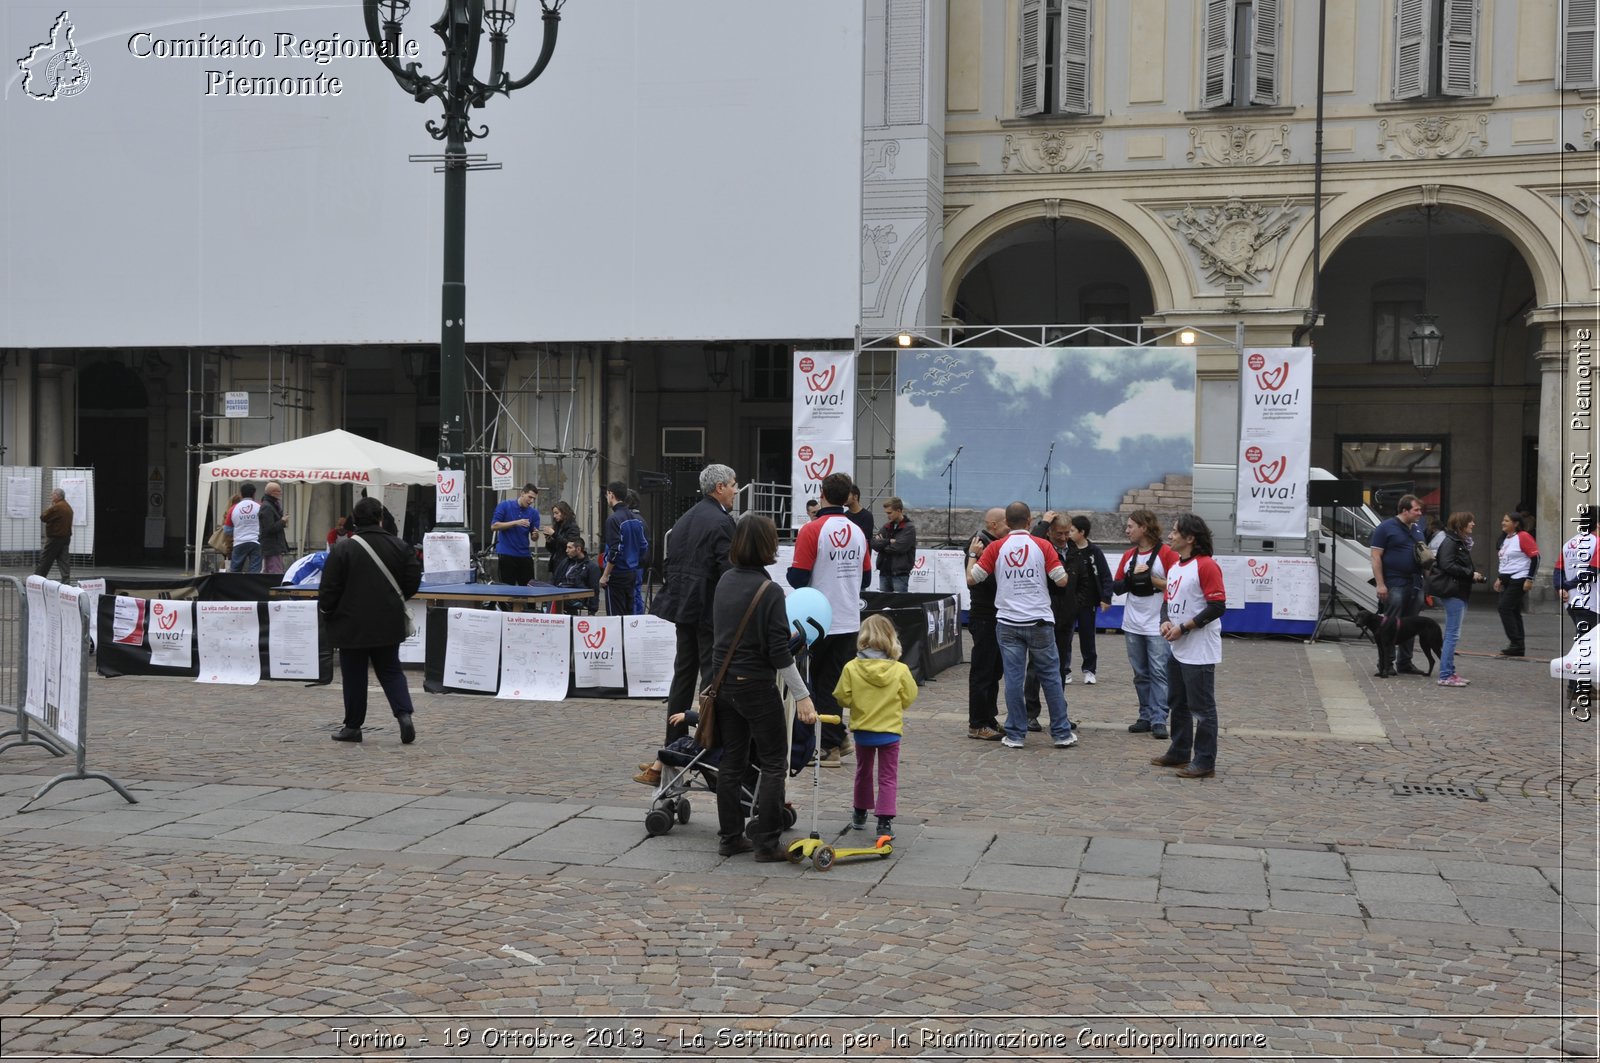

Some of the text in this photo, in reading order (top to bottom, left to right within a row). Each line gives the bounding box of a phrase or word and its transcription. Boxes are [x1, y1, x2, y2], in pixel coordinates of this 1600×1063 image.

[805, 390, 844, 405] viva!
[1255, 388, 1299, 405] viva!
[212, 468, 370, 482] CROCE ROSSA ITALIANA
[438, 492, 460, 502] viva!
[1251, 483, 1296, 499] viva!
[830, 546, 860, 560] viva!
[1005, 564, 1039, 579] viva!
[156, 629, 184, 640] viva!
[582, 647, 614, 660] viva!
